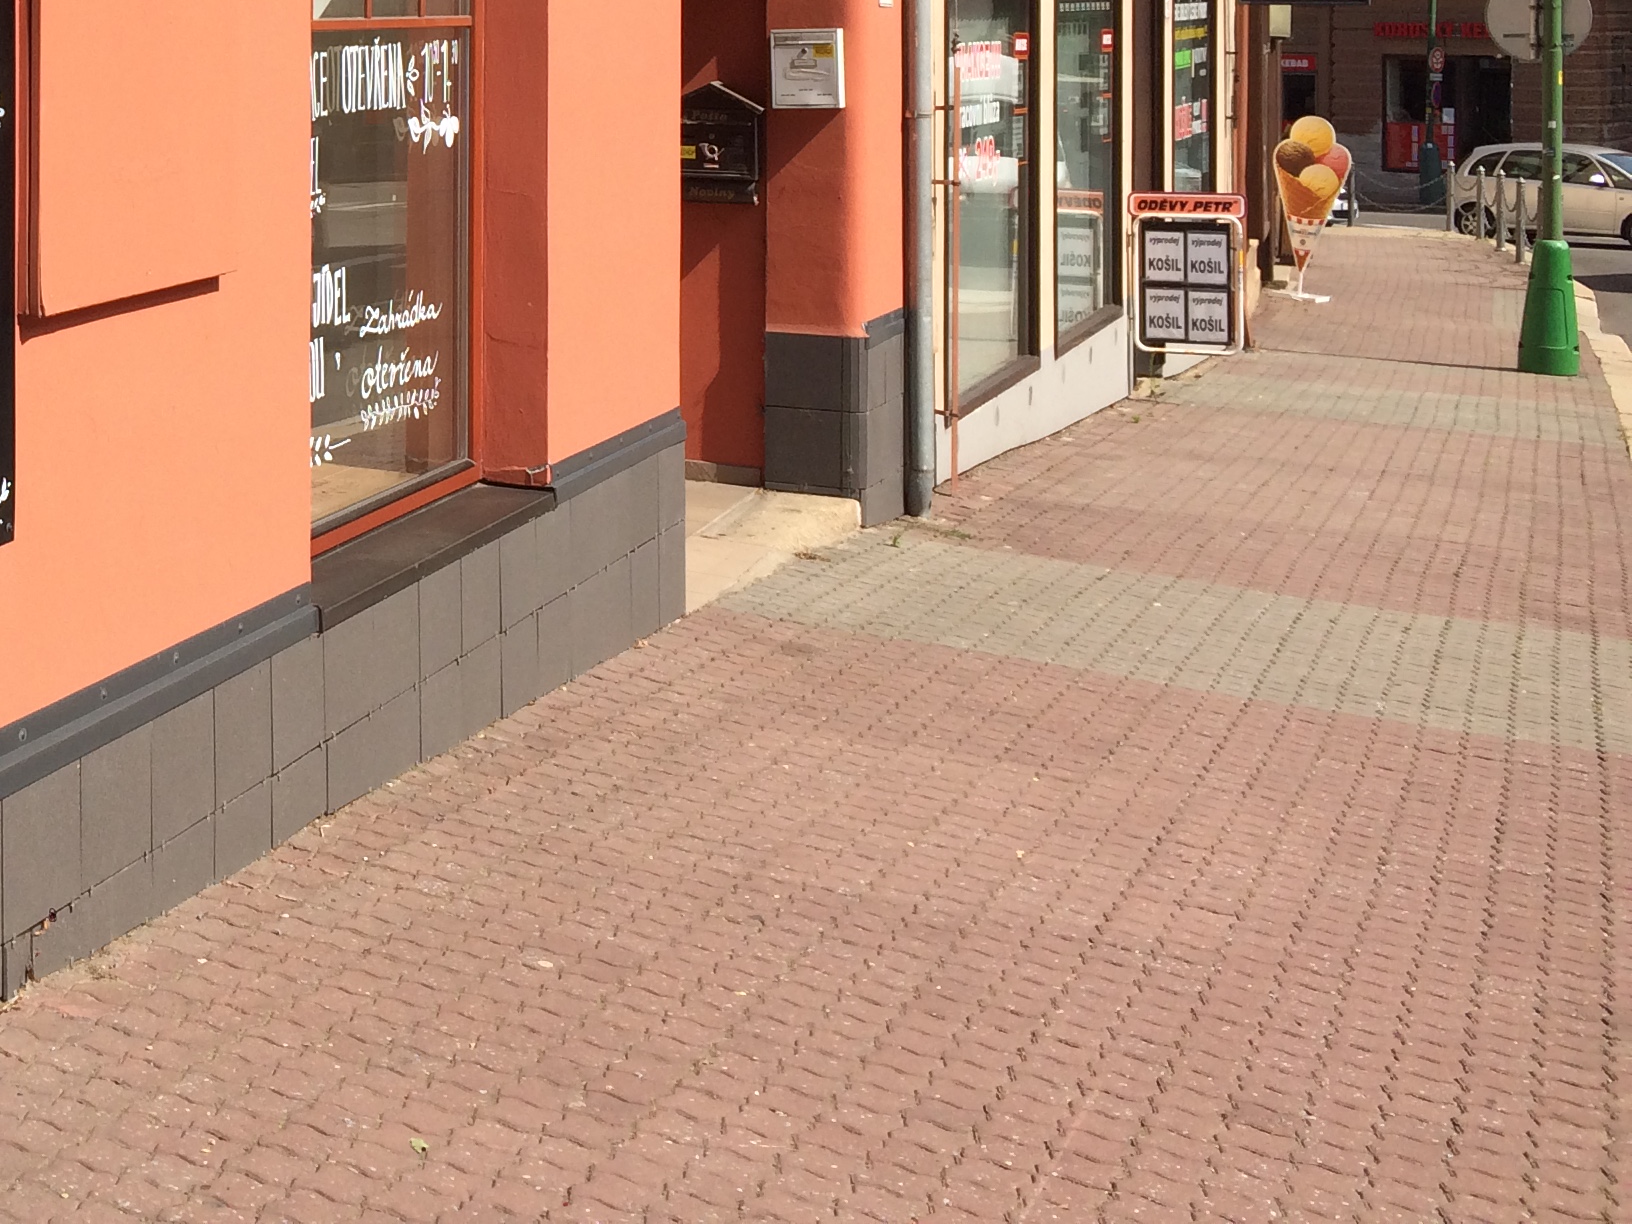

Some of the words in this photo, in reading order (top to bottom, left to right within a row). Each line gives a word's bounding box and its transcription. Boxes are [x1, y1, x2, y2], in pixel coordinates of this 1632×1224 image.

[341, 36, 407, 114] OTEVŘENA
[1137, 197, 1186, 212] ODĚVY
[1149, 235, 1180, 246] výprodej
[1191, 237, 1222, 248] výprodej
[1148, 255, 1182, 272] KOŠIL
[1190, 257, 1224, 275] KOŠIL
[1149, 293, 1180, 304] výprodej
[1192, 295, 1223, 306] výprodej
[1148, 313, 1183, 329] KOŠIL
[1191, 315, 1225, 332] KOŠIL
